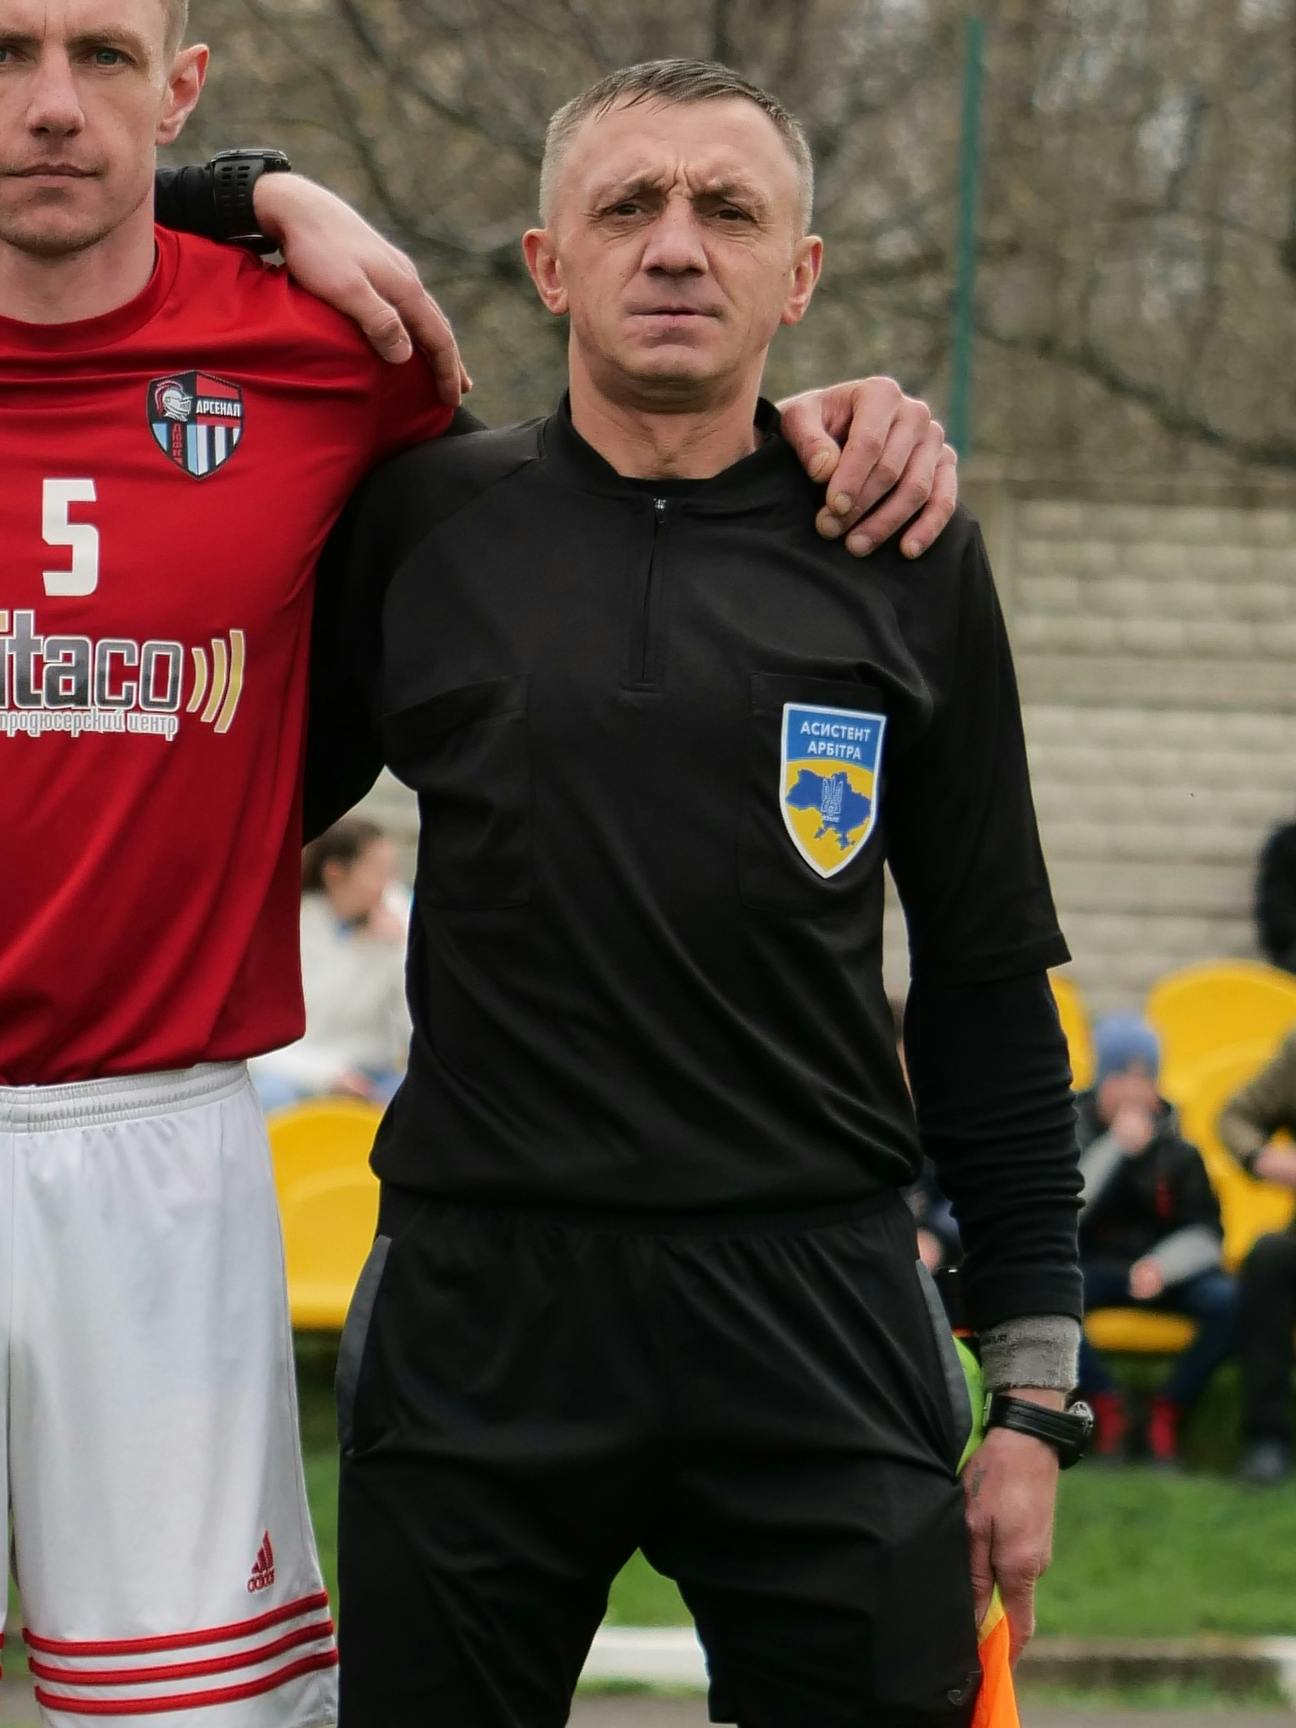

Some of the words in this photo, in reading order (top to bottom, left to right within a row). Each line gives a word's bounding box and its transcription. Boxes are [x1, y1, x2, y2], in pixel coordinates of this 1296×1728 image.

[196, 399, 241, 417] АРСЕНАЛ
[41, 478, 99, 596] 5
[127, 711, 179, 741] центр
[800, 721, 872, 742] АСИСТЕНТ
[807, 742, 861, 760] АРБІТРА
